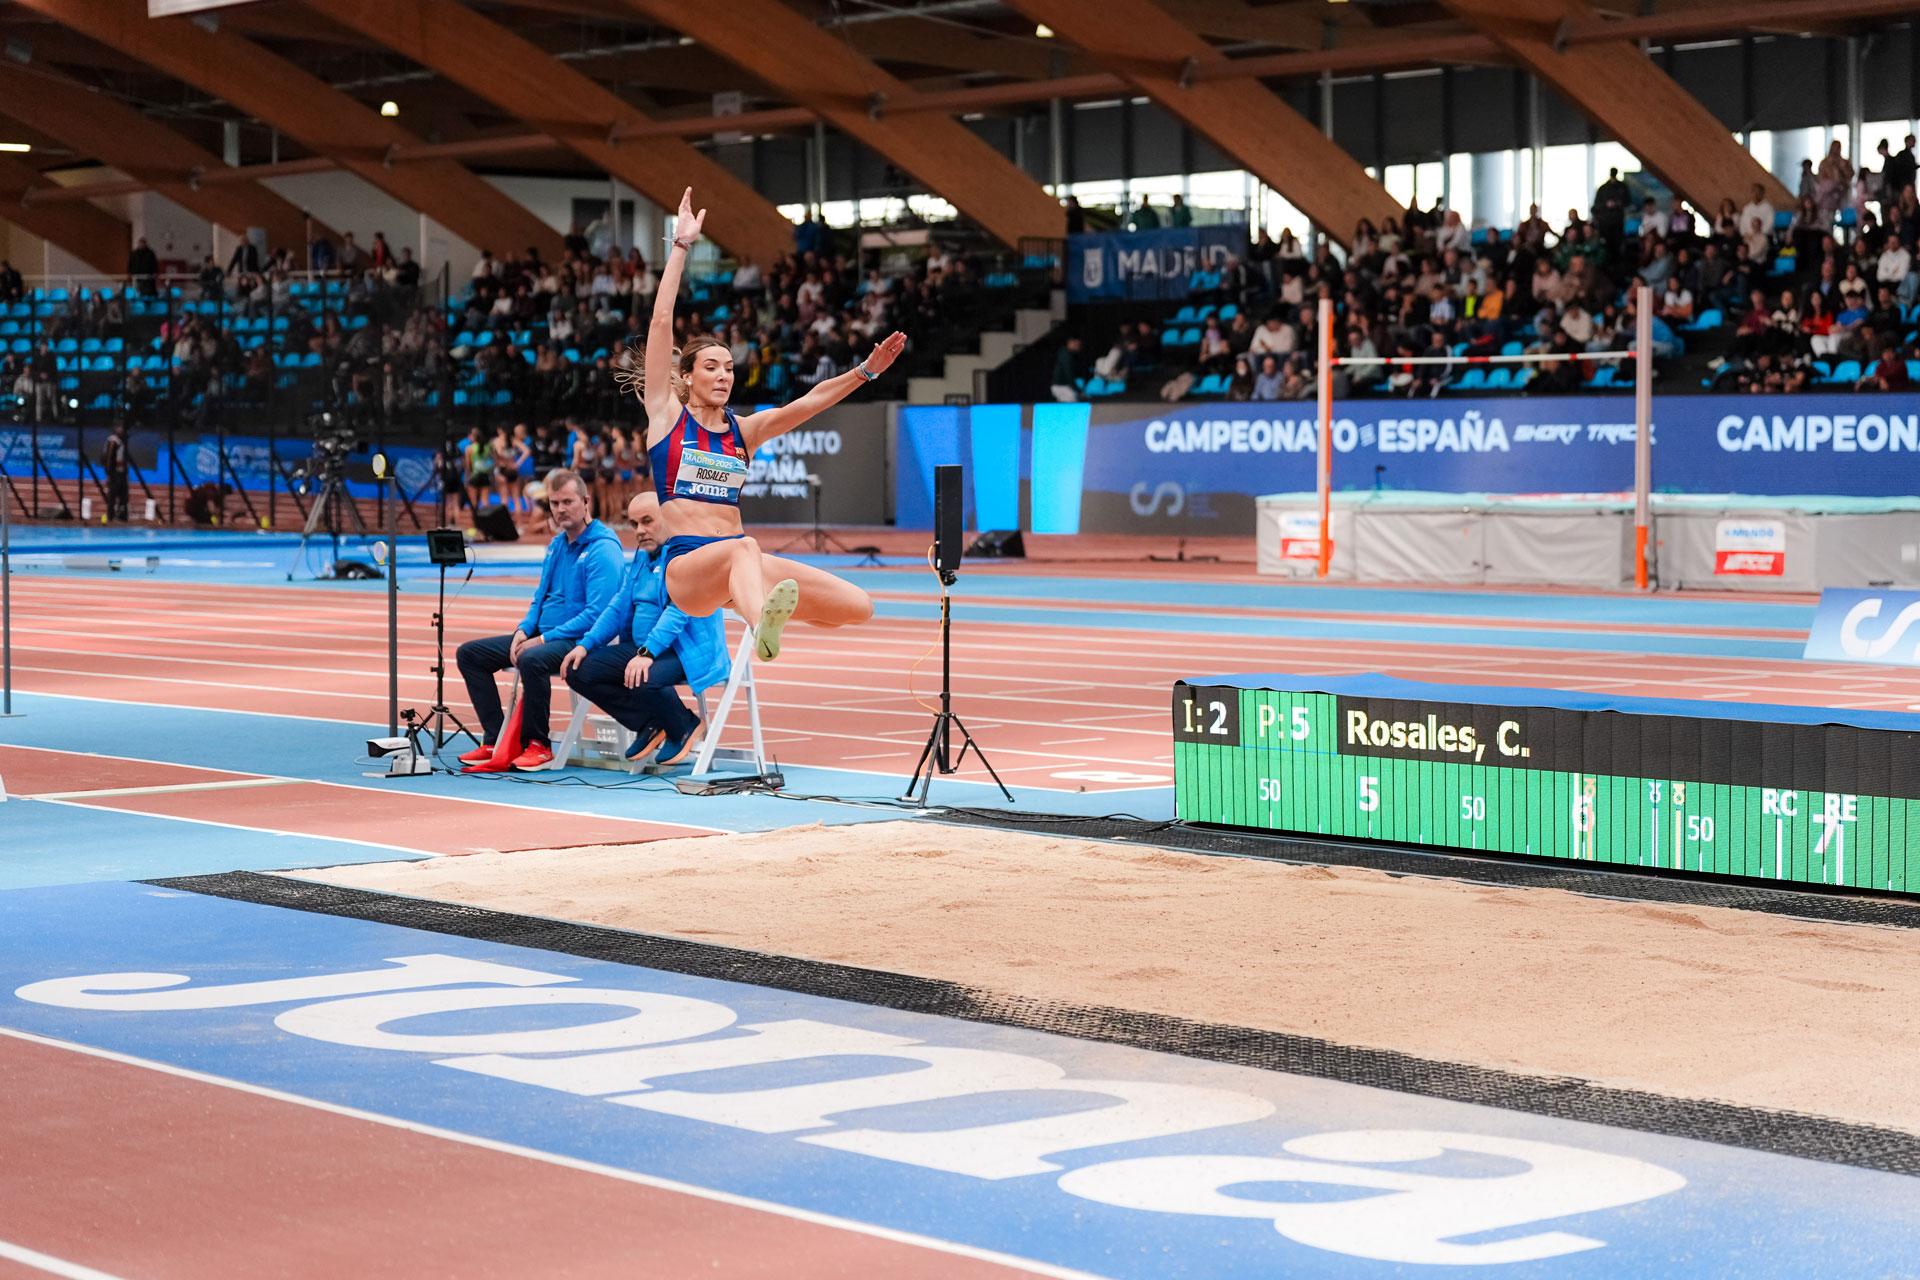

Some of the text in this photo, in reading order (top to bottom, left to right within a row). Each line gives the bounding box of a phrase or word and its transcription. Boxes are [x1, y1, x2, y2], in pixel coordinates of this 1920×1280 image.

[1378, 410, 1510, 453] ESPAÑA
[1716, 414, 1920, 453] CAMPEON
[684, 452, 715, 466] MADRID
[696, 467, 730, 483] ROSALES
[745, 454, 808, 483] SPAÑA
[1347, 710, 1486, 762] Rosales,
[1497, 720, 1531, 758] C.
[1259, 778, 1281, 803] 50
[1359, 776, 1379, 812] 5
[1462, 795, 1486, 822] 50
[1688, 815, 1714, 842] 50
[1761, 787, 1798, 816] RC
